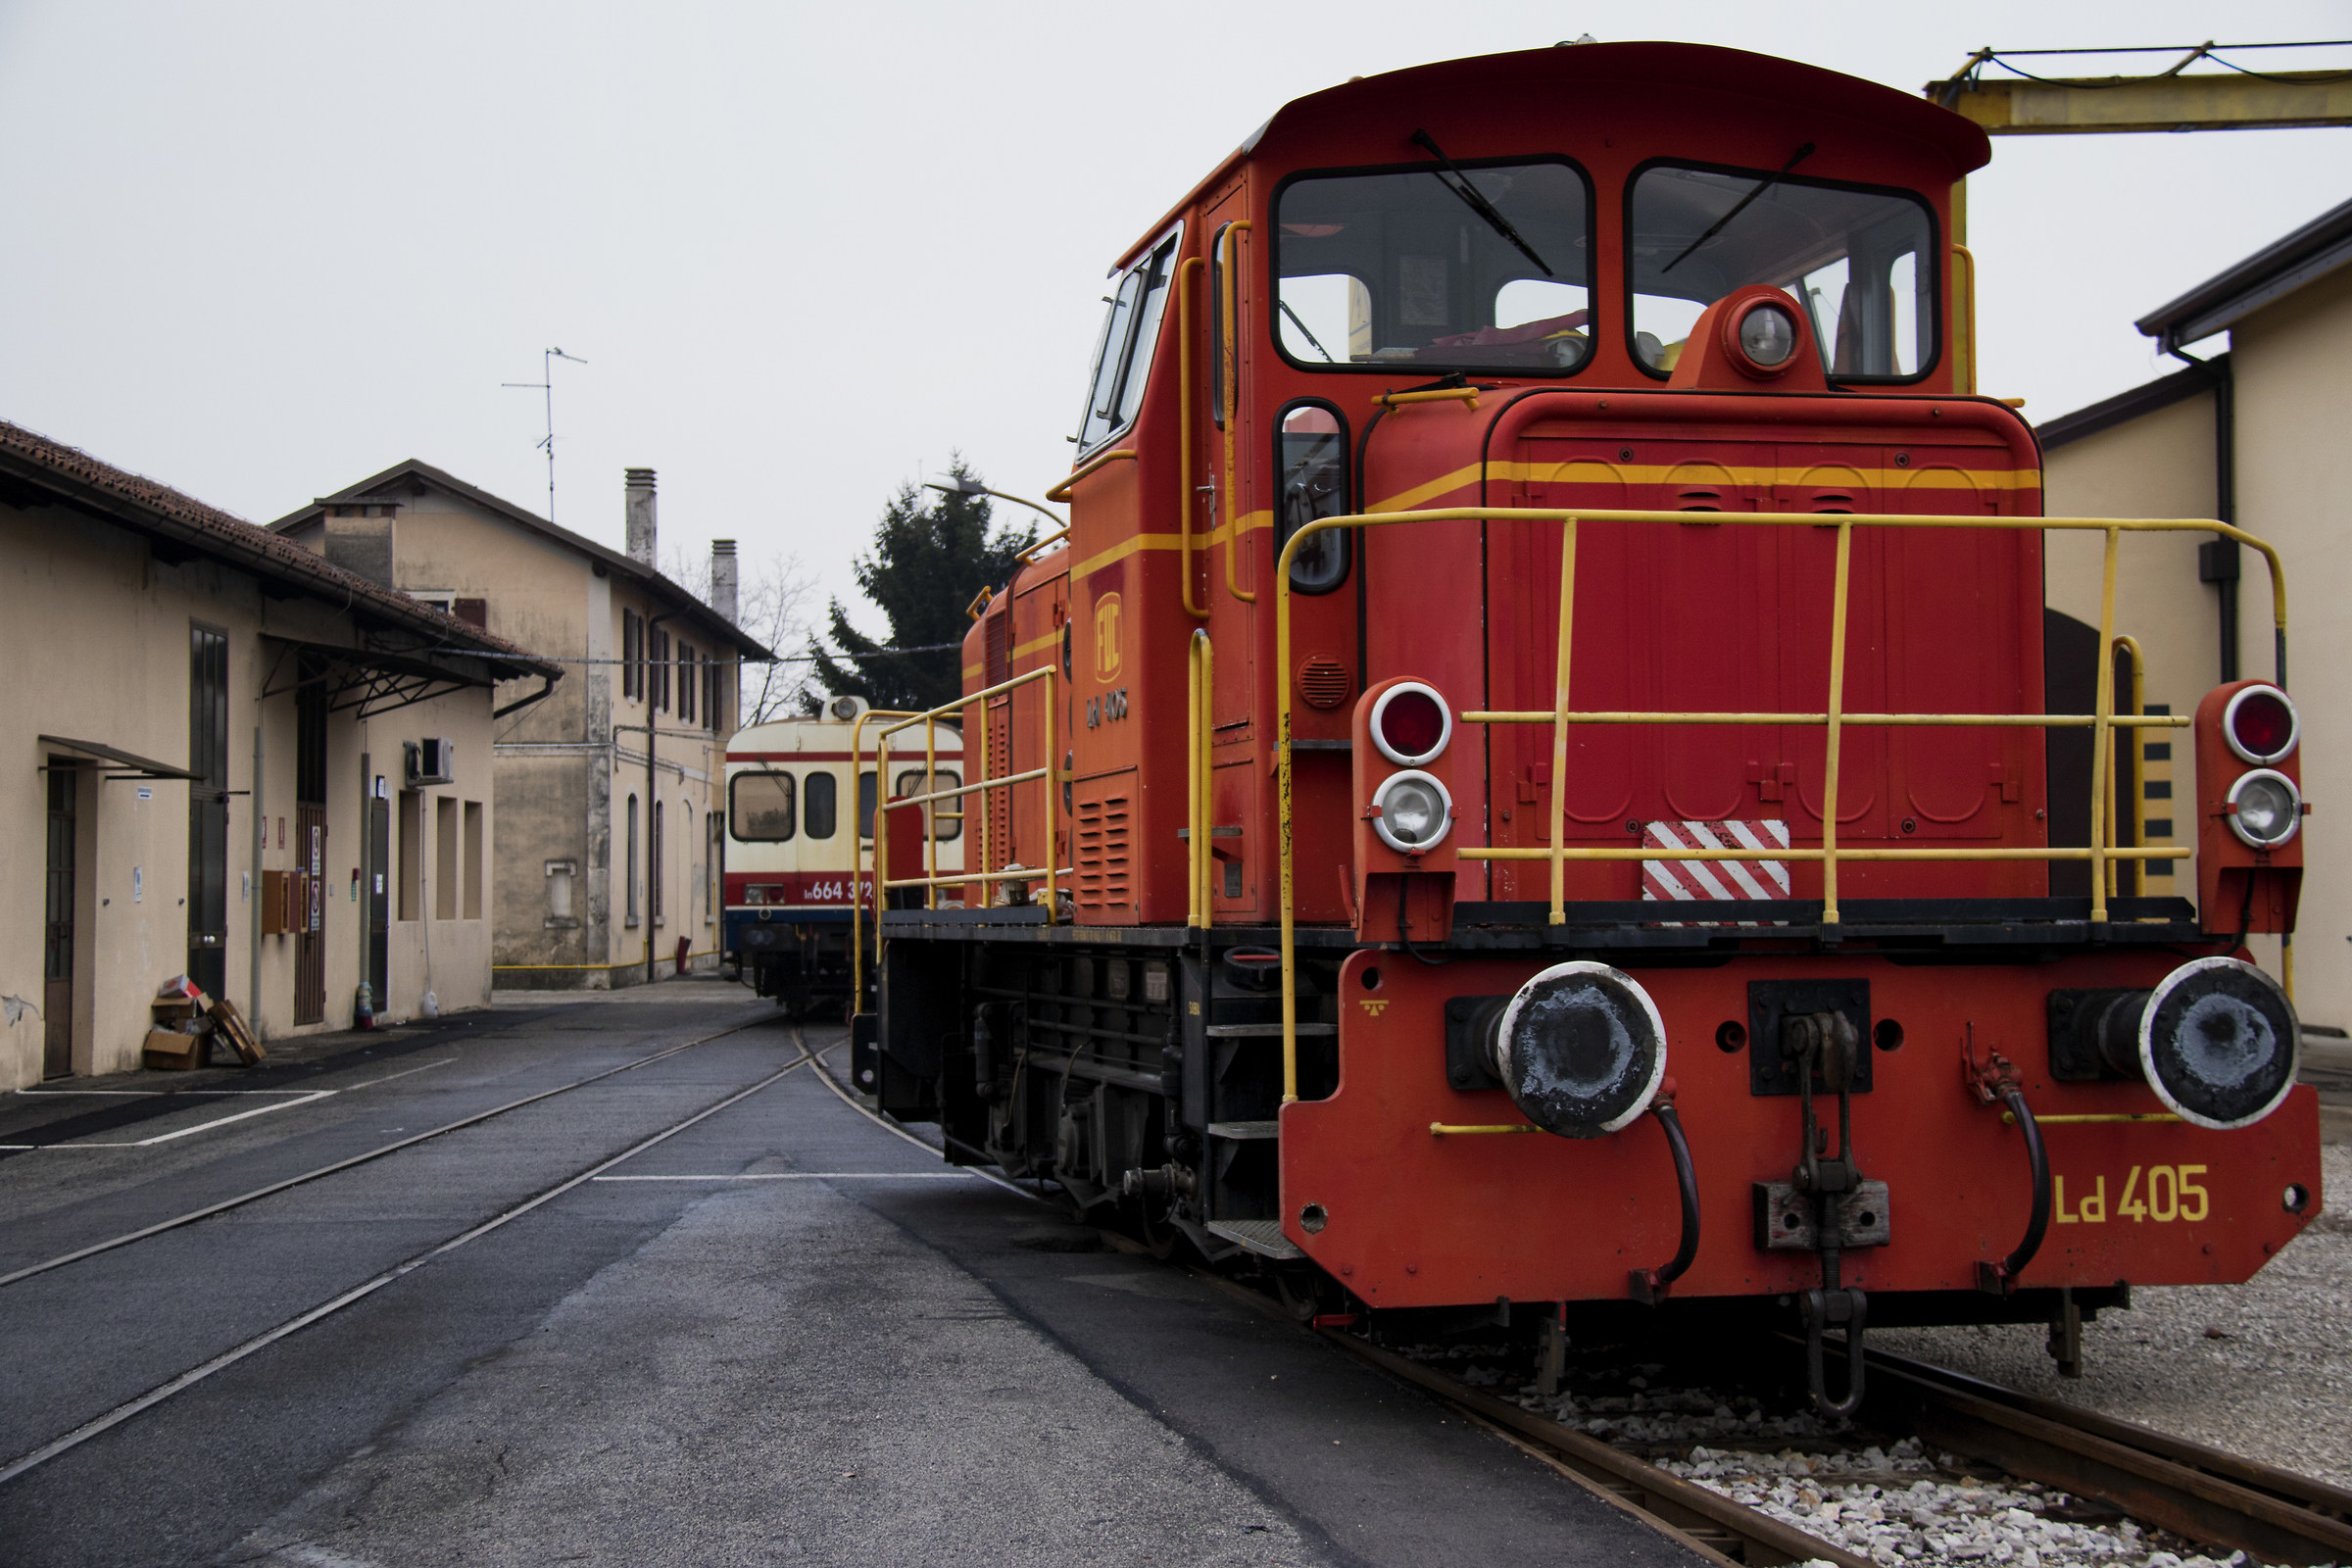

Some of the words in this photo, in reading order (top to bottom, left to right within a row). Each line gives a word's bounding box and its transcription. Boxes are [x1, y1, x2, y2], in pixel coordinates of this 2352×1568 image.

[1104, 687, 1127, 722] 405
[2055, 1175, 2106, 1223] Ld
[2117, 1164, 2209, 1222] 405
